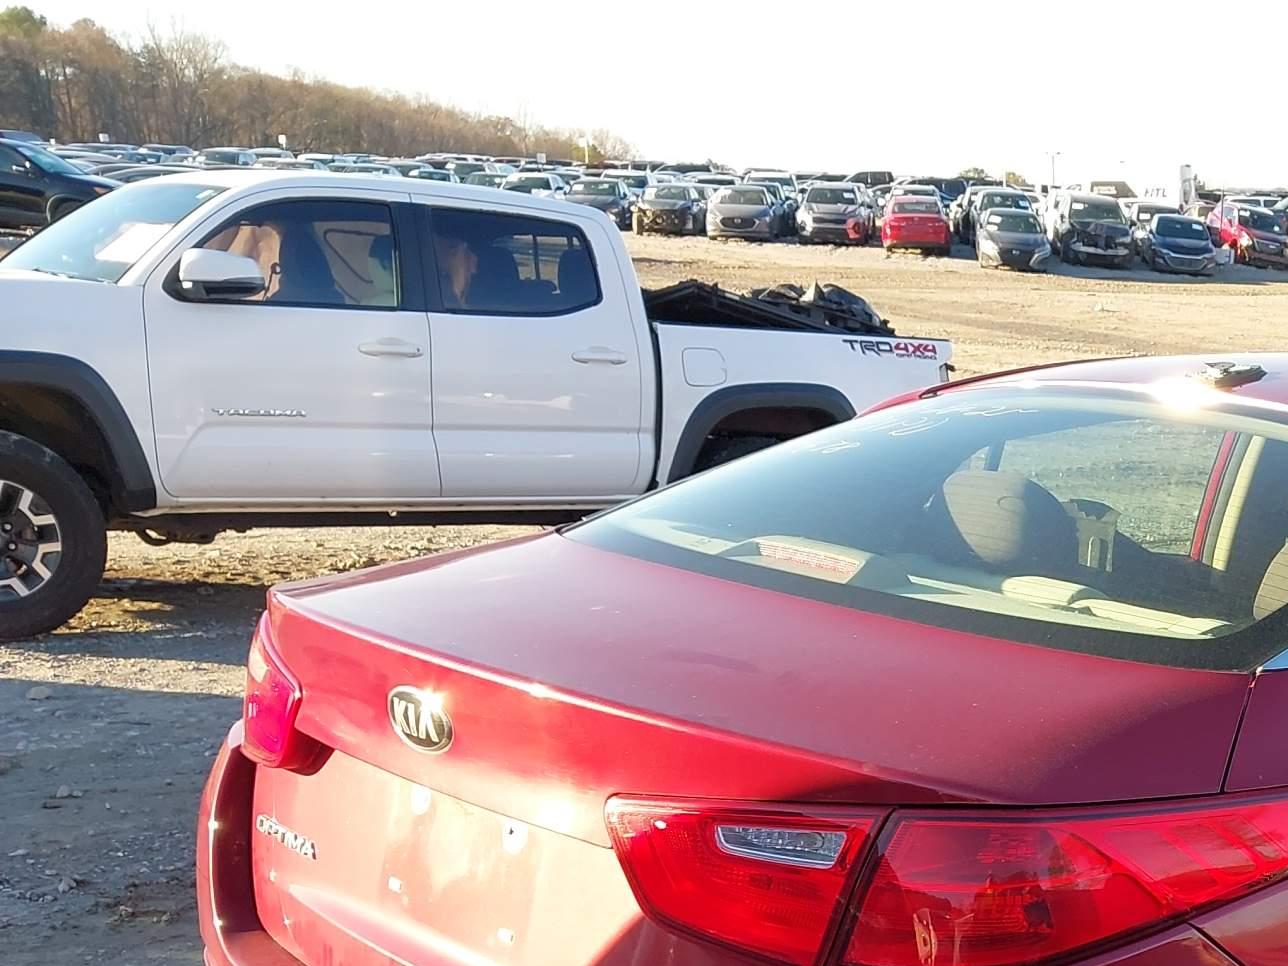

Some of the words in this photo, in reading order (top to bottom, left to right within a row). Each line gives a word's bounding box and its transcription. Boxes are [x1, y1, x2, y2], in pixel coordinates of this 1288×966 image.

[842, 339, 894, 357] TRD
[211, 408, 308, 418] TACOMA
[392, 695, 441, 744] KIA
[256, 815, 317, 860] OPTIMA
